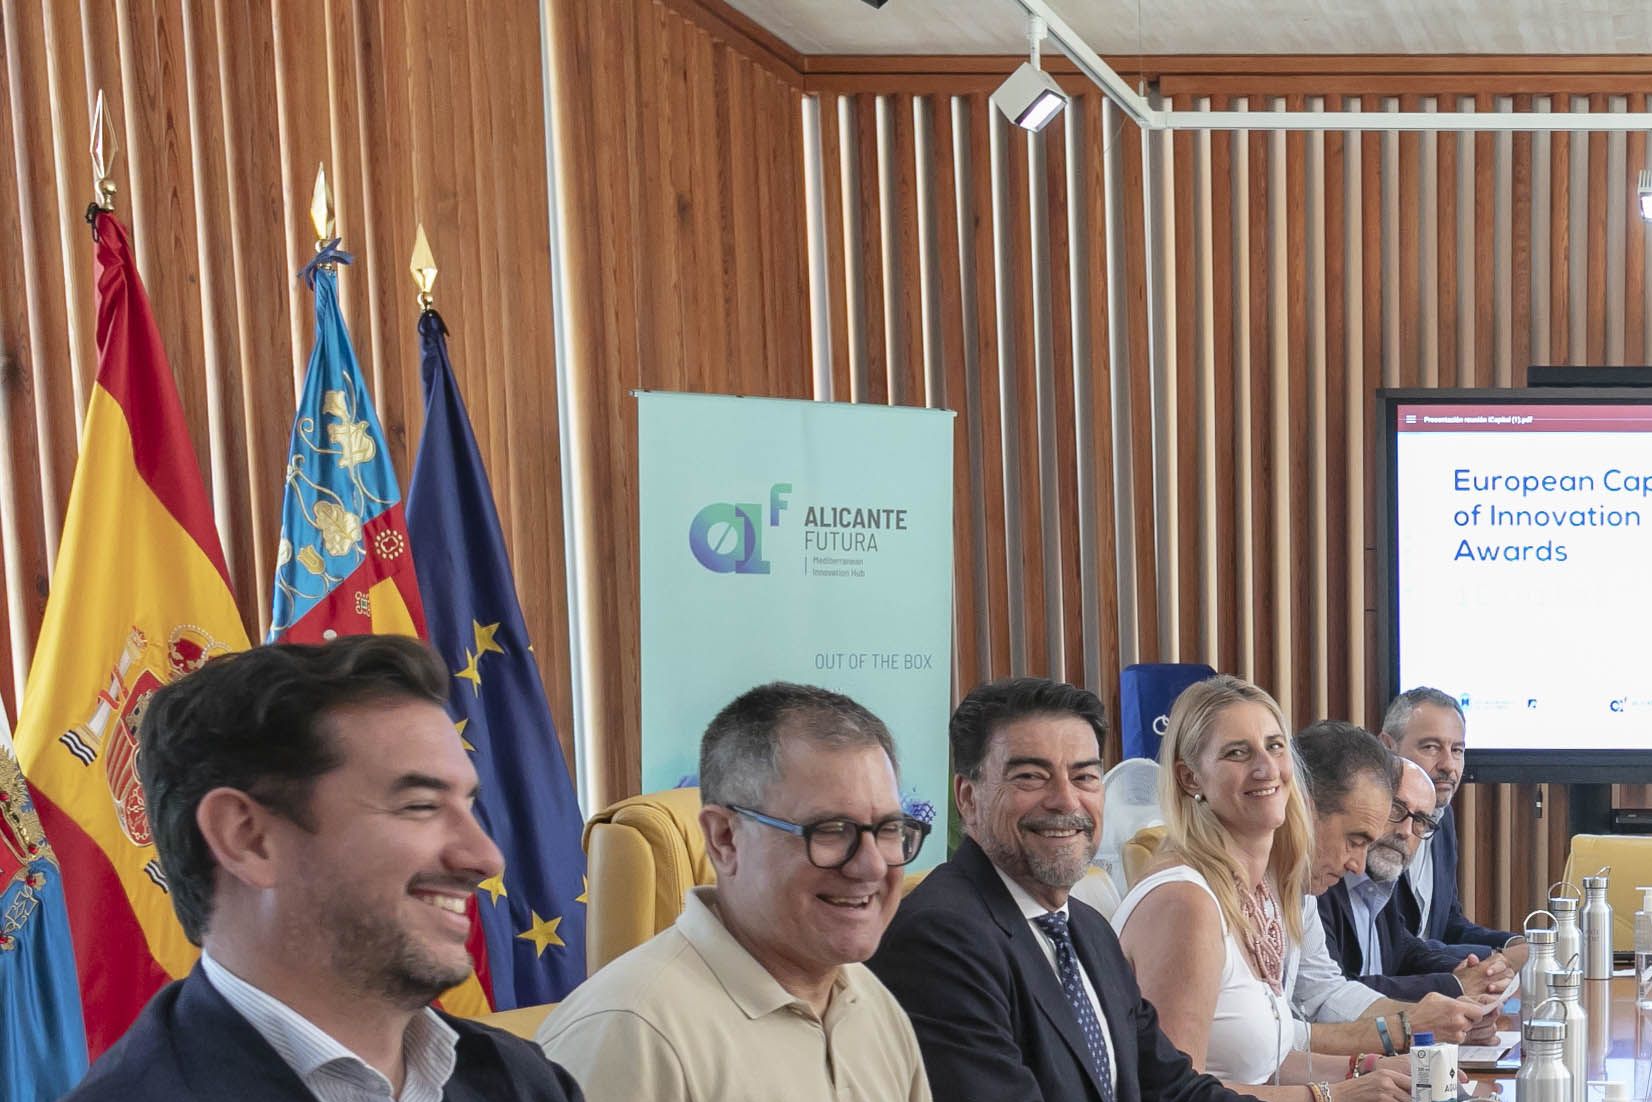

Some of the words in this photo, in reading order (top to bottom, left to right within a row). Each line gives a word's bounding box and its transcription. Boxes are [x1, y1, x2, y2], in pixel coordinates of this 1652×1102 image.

[1454, 469, 1594, 497] European
[804, 506, 907, 530] ALICANTE
[1454, 504, 1482, 527] of
[1490, 504, 1641, 527] Innovation
[805, 530, 878, 552] FUTURA
[1453, 539, 1568, 562] Awards
[812, 568, 849, 577] Innovation
[851, 569, 866, 577] Hub
[815, 653, 844, 670] OUT
[848, 653, 868, 670] OF
[872, 654, 899, 670] THE
[904, 654, 932, 670] BOX
